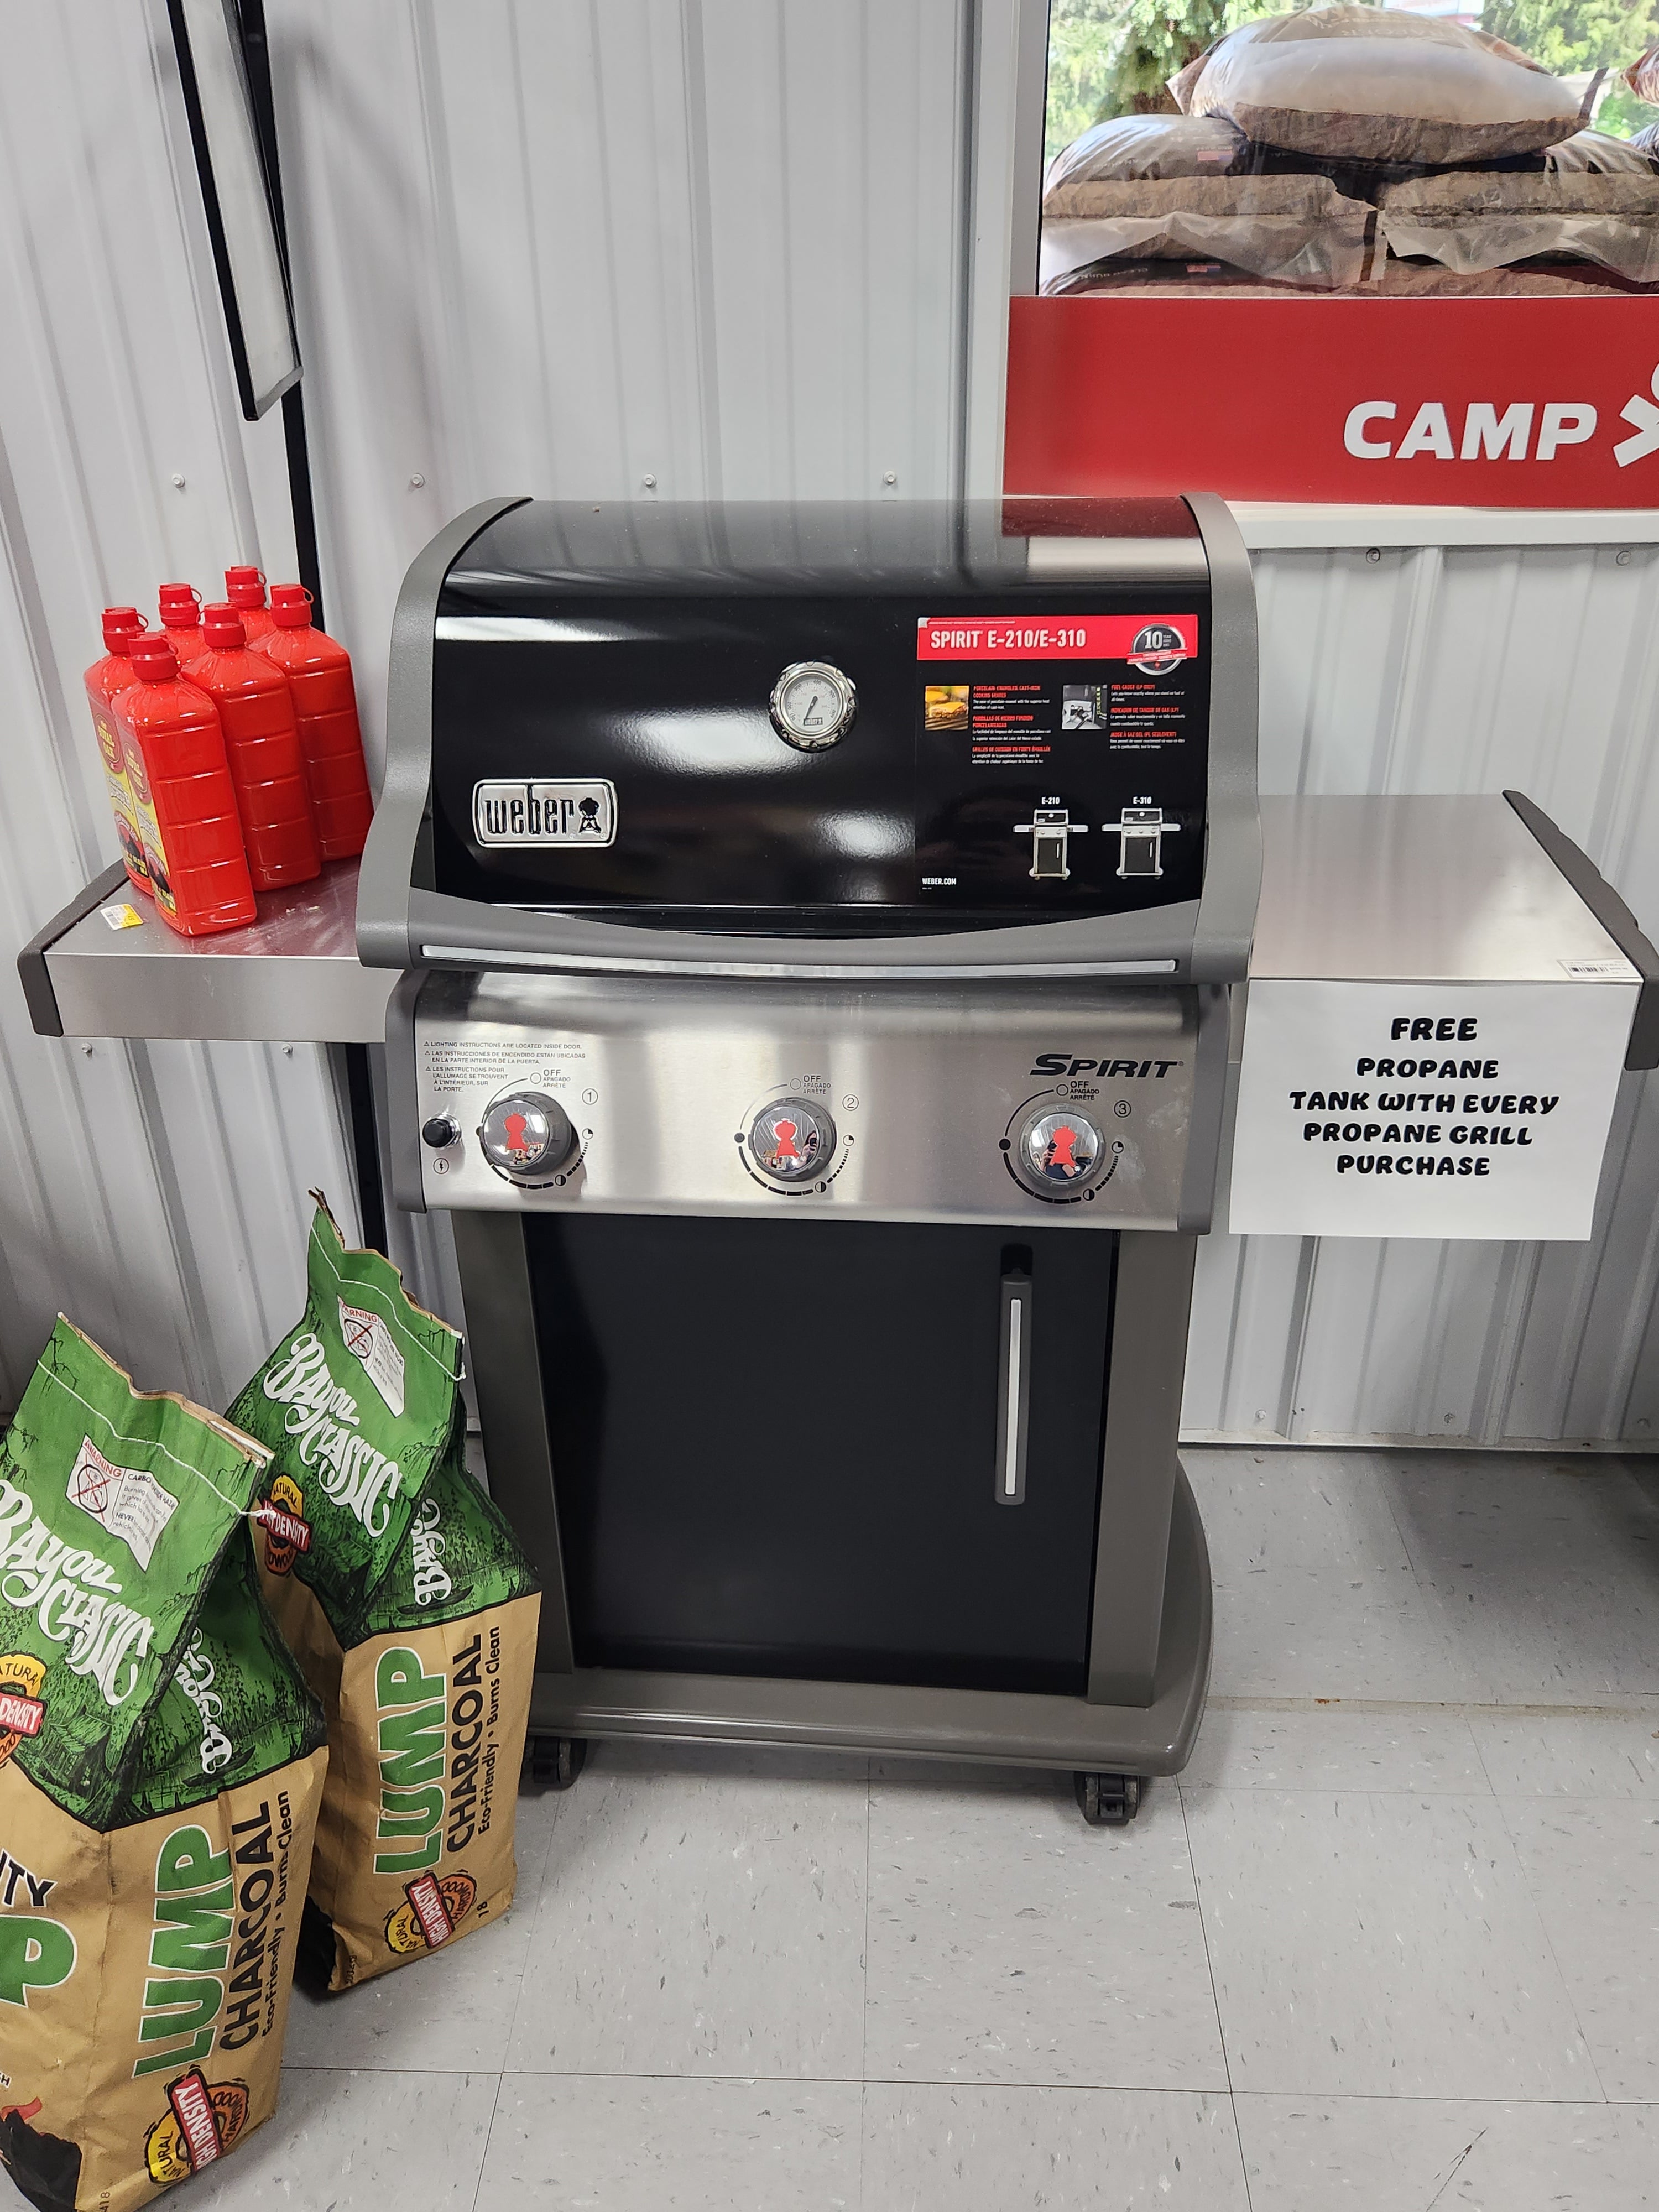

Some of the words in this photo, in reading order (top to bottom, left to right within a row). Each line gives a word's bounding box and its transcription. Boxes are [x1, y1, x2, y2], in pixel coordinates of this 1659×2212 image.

[1344, 401, 1598, 460] CAMP
[930, 630, 981, 648] SPIRIT
[987, 629, 1087, 648] E-210/E-310
[1145, 630, 1162, 649] 10
[484, 784, 575, 834] weber
[1041, 796, 1060, 805] E-210
[1133, 796, 1152, 805] E-310
[922, 877, 957, 886] WEBER.COM
[1390, 1017, 1478, 1041] FREE
[1357, 1058, 1499, 1079] PROPANE
[1289, 1091, 1370, 1111] TANK
[1378, 1093, 1454, 1114] WITH
[1463, 1095, 1559, 1115] EVERY
[1303, 1123, 1441, 1144] PROPANE
[1448, 1125, 1532, 1146] GRILL
[1337, 1154, 1490, 1176] PURCHASE
[124, 1485, 146, 1496] Burning
[128, 1473, 152, 1483] CARBO
[275, 1513, 309, 1547] DENSITY
[486, 1626, 500, 1674] Clean
[1, 1698, 42, 1730] DENSITY
[487, 1678, 500, 1728] Burns
[447, 1634, 483, 1853] CHARCOAL
[373, 1646, 447, 1874] LUMP
[478, 1741, 499, 1834] Eco-Friendly
[262, 1925, 285, 2037] Eco-Friendly
[277, 1790, 293, 1850] Clean
[411, 1881, 442, 1924] DENSITY
[477, 1901, 489, 1918] 18
[219, 1801, 274, 2050] CHARCOAL
[131, 1824, 236, 2078] LUMP
[175, 2083, 215, 2149] DENSITY
